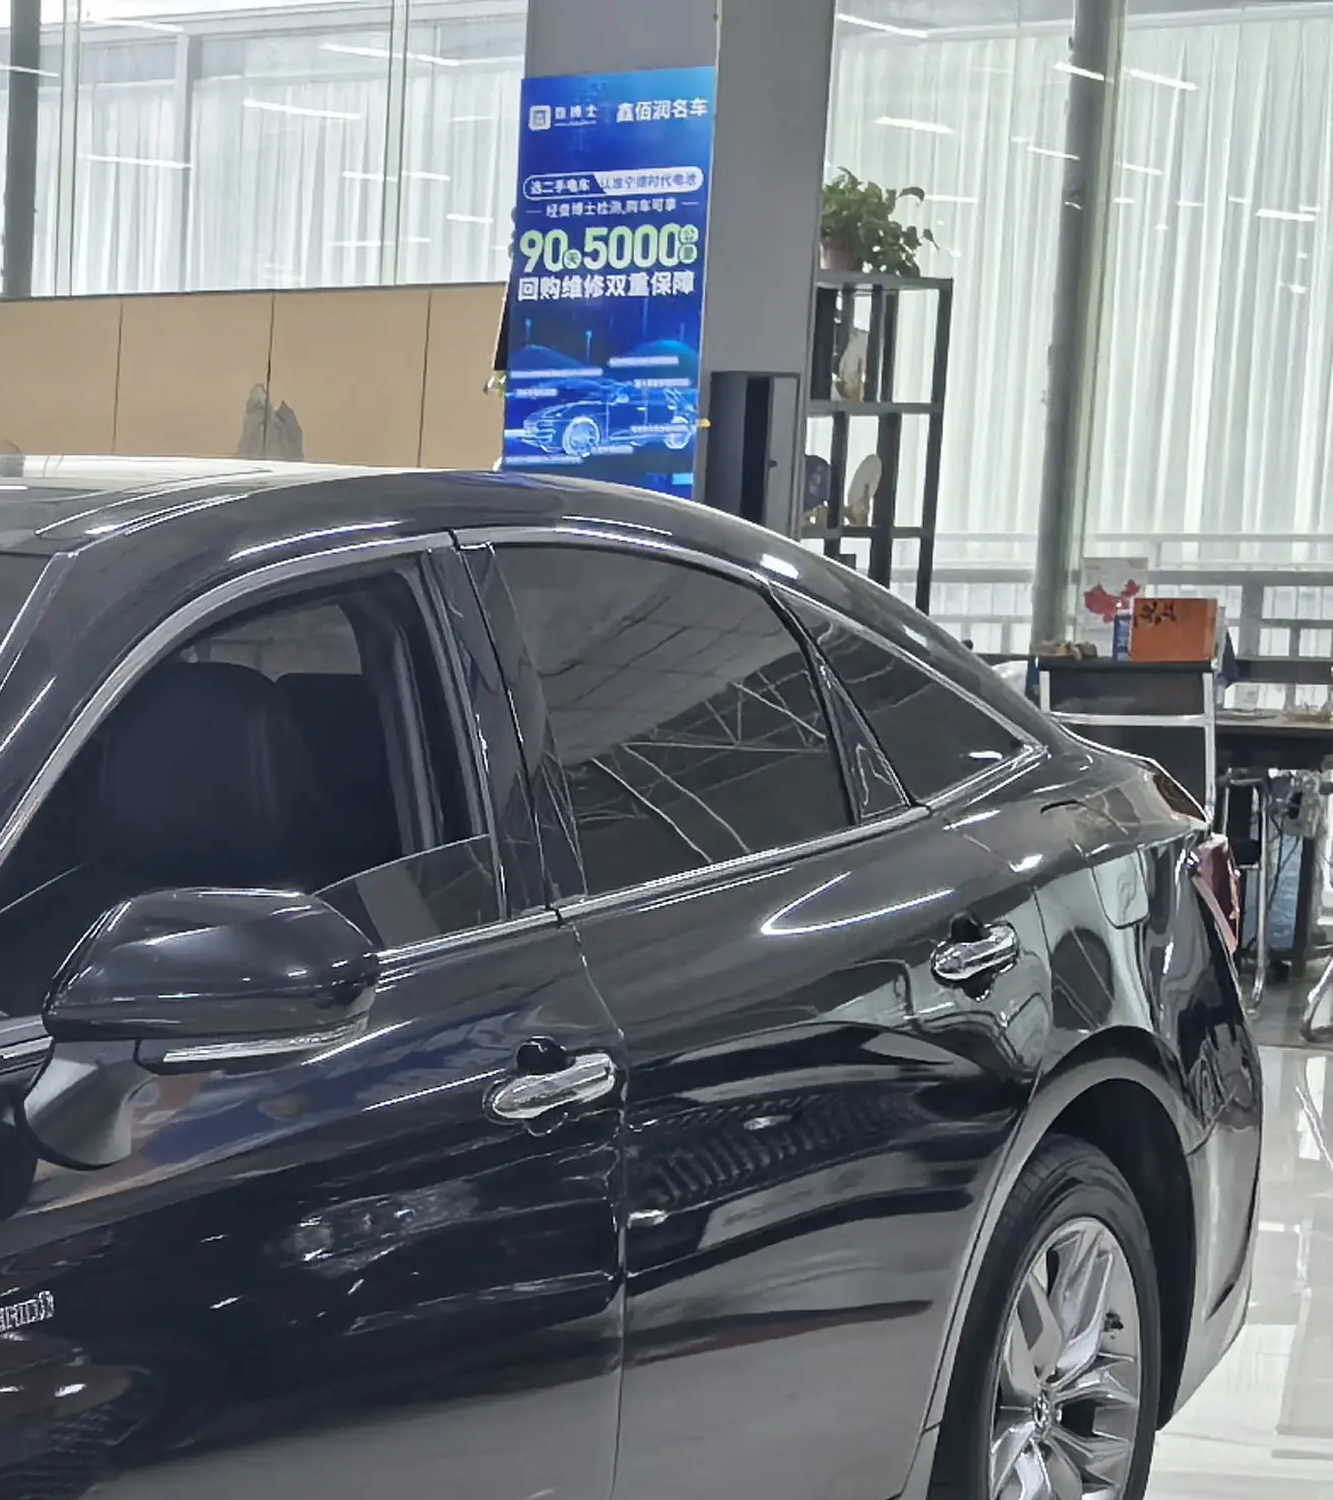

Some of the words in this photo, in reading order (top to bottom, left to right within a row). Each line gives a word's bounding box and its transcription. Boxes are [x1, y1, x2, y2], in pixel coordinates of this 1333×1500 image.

[517, 270, 695, 301] 回购维修双重保障
